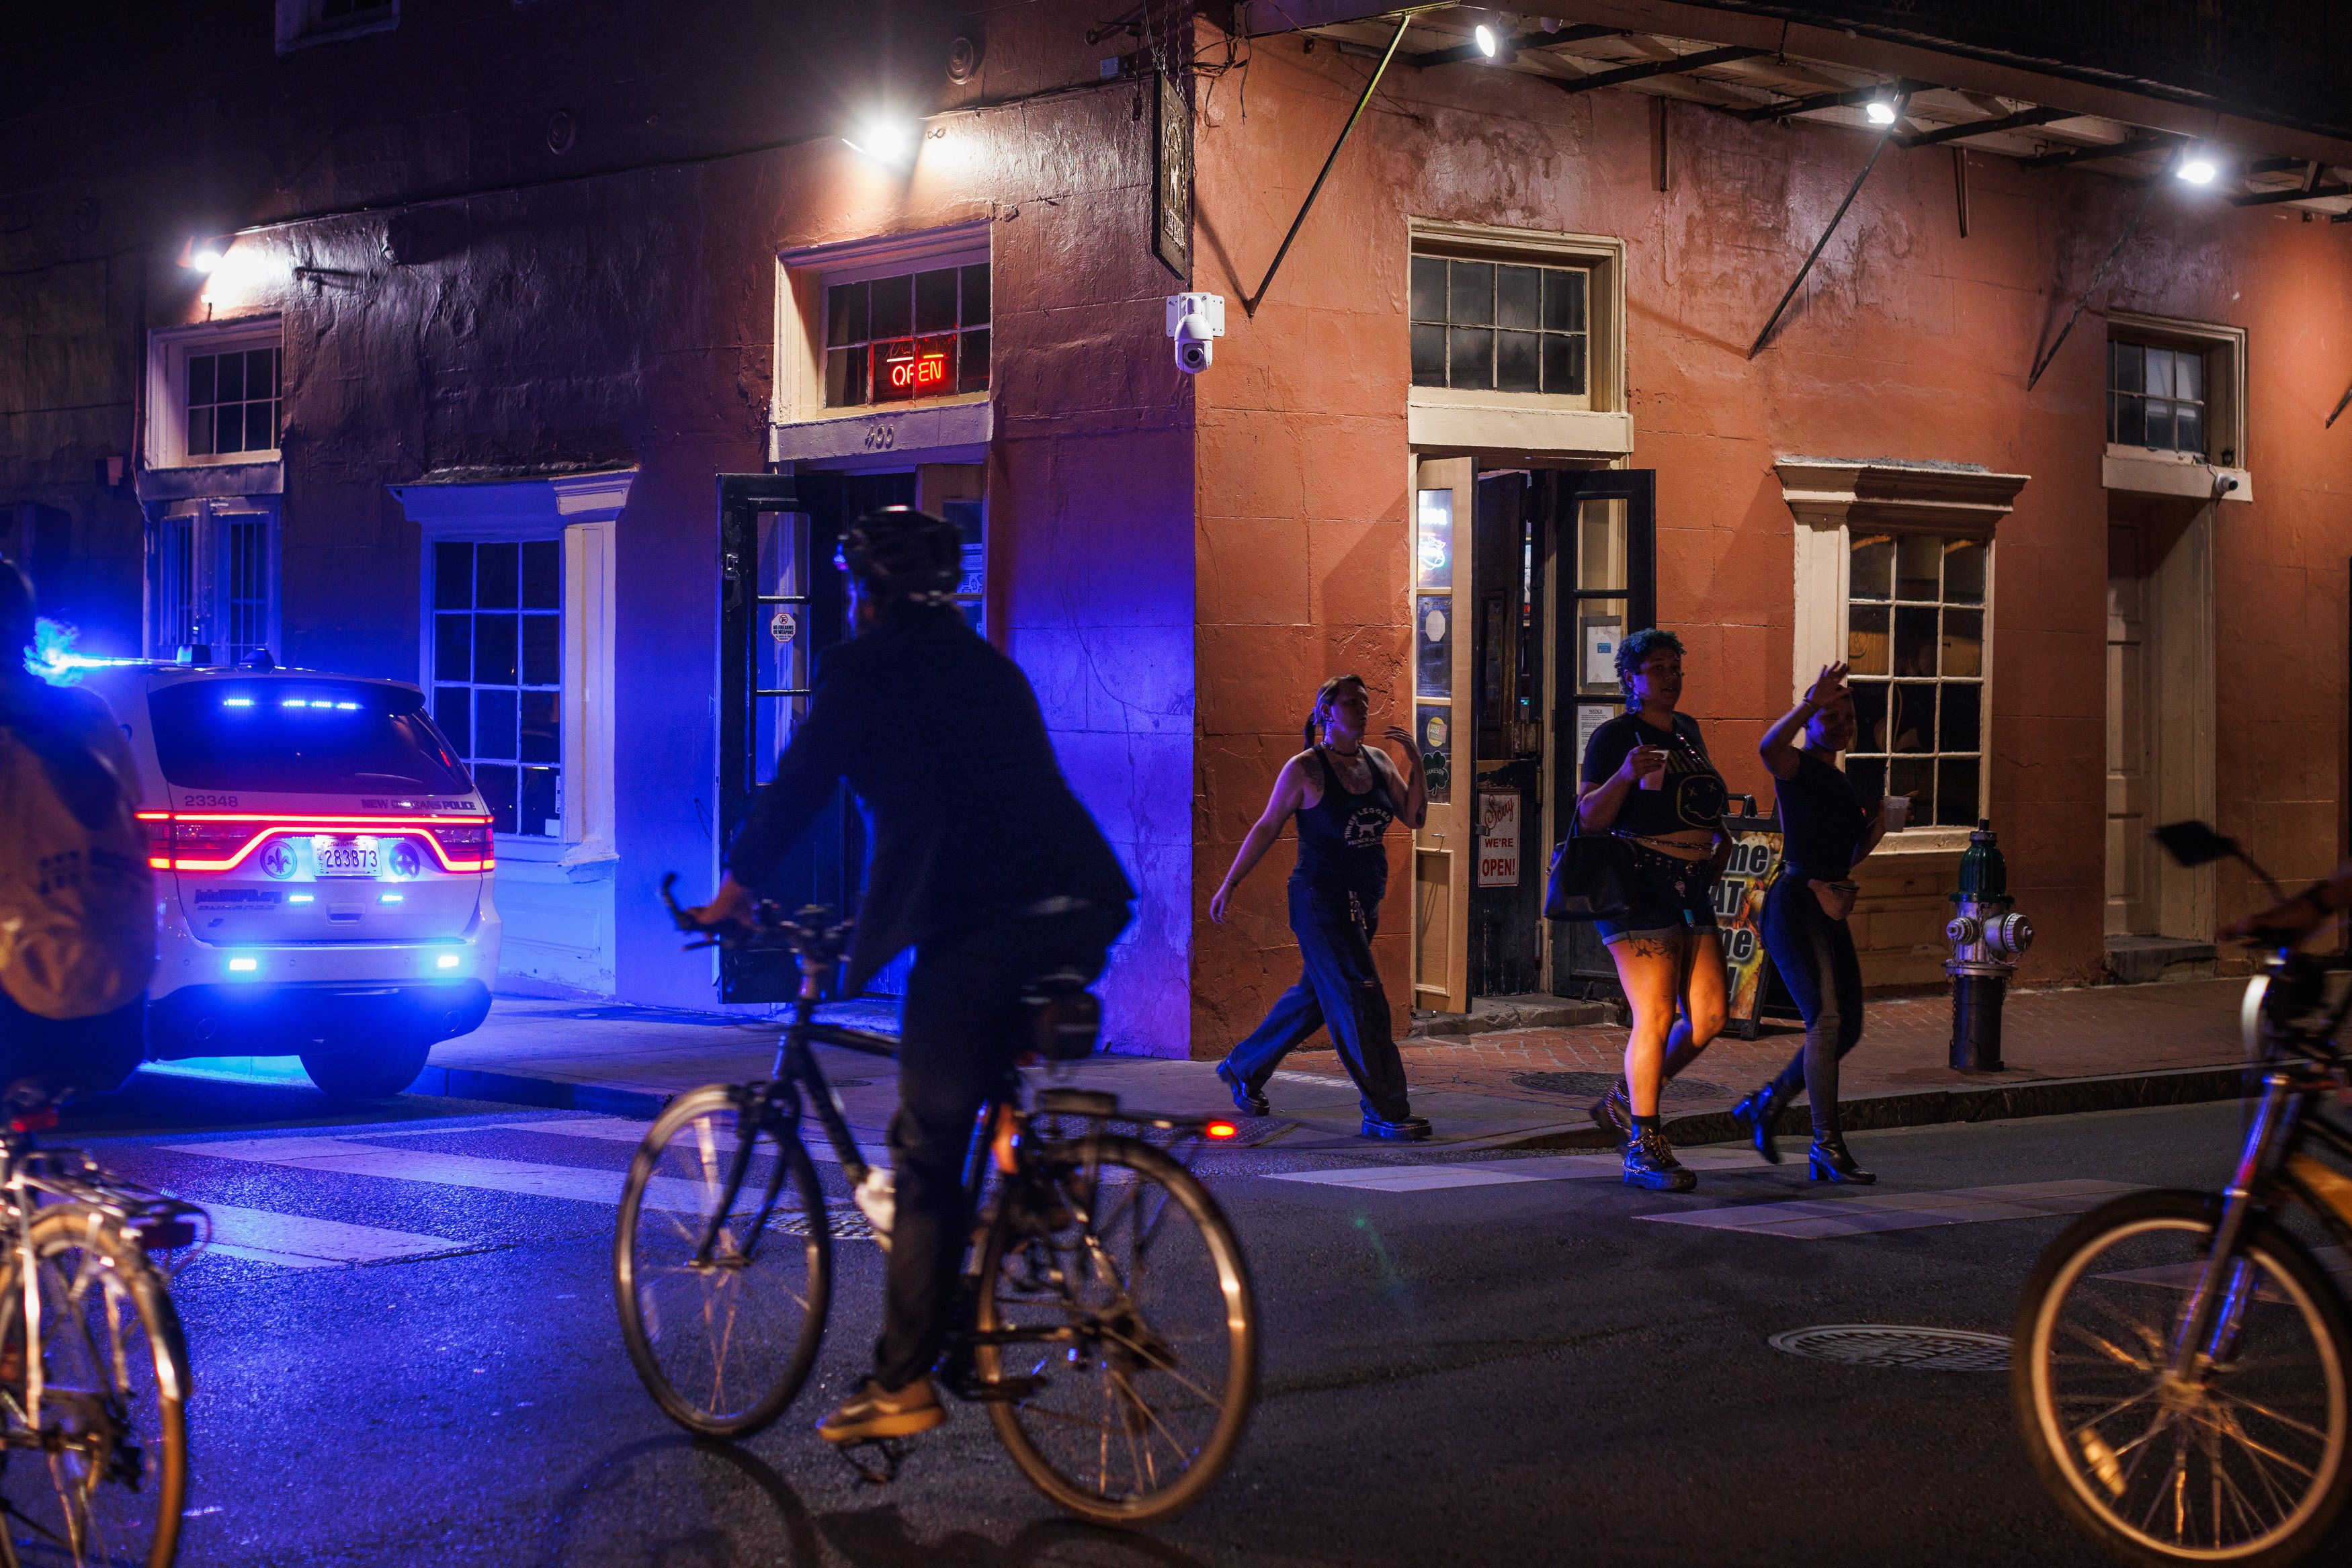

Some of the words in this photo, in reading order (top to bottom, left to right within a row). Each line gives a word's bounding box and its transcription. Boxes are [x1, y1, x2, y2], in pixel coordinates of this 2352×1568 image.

[892, 360, 941, 386] OPEN
[1426, 768, 1444, 776] JAMESON
[185, 795, 238, 807] 23348
[361, 799, 388, 809] NEW
[443, 800, 476, 811] POLICE
[1484, 795, 1514, 830] Sorry
[1485, 838, 1513, 848] WE'RE
[325, 849, 378, 867] 283873
[1482, 859, 1515, 877] OPEN!
